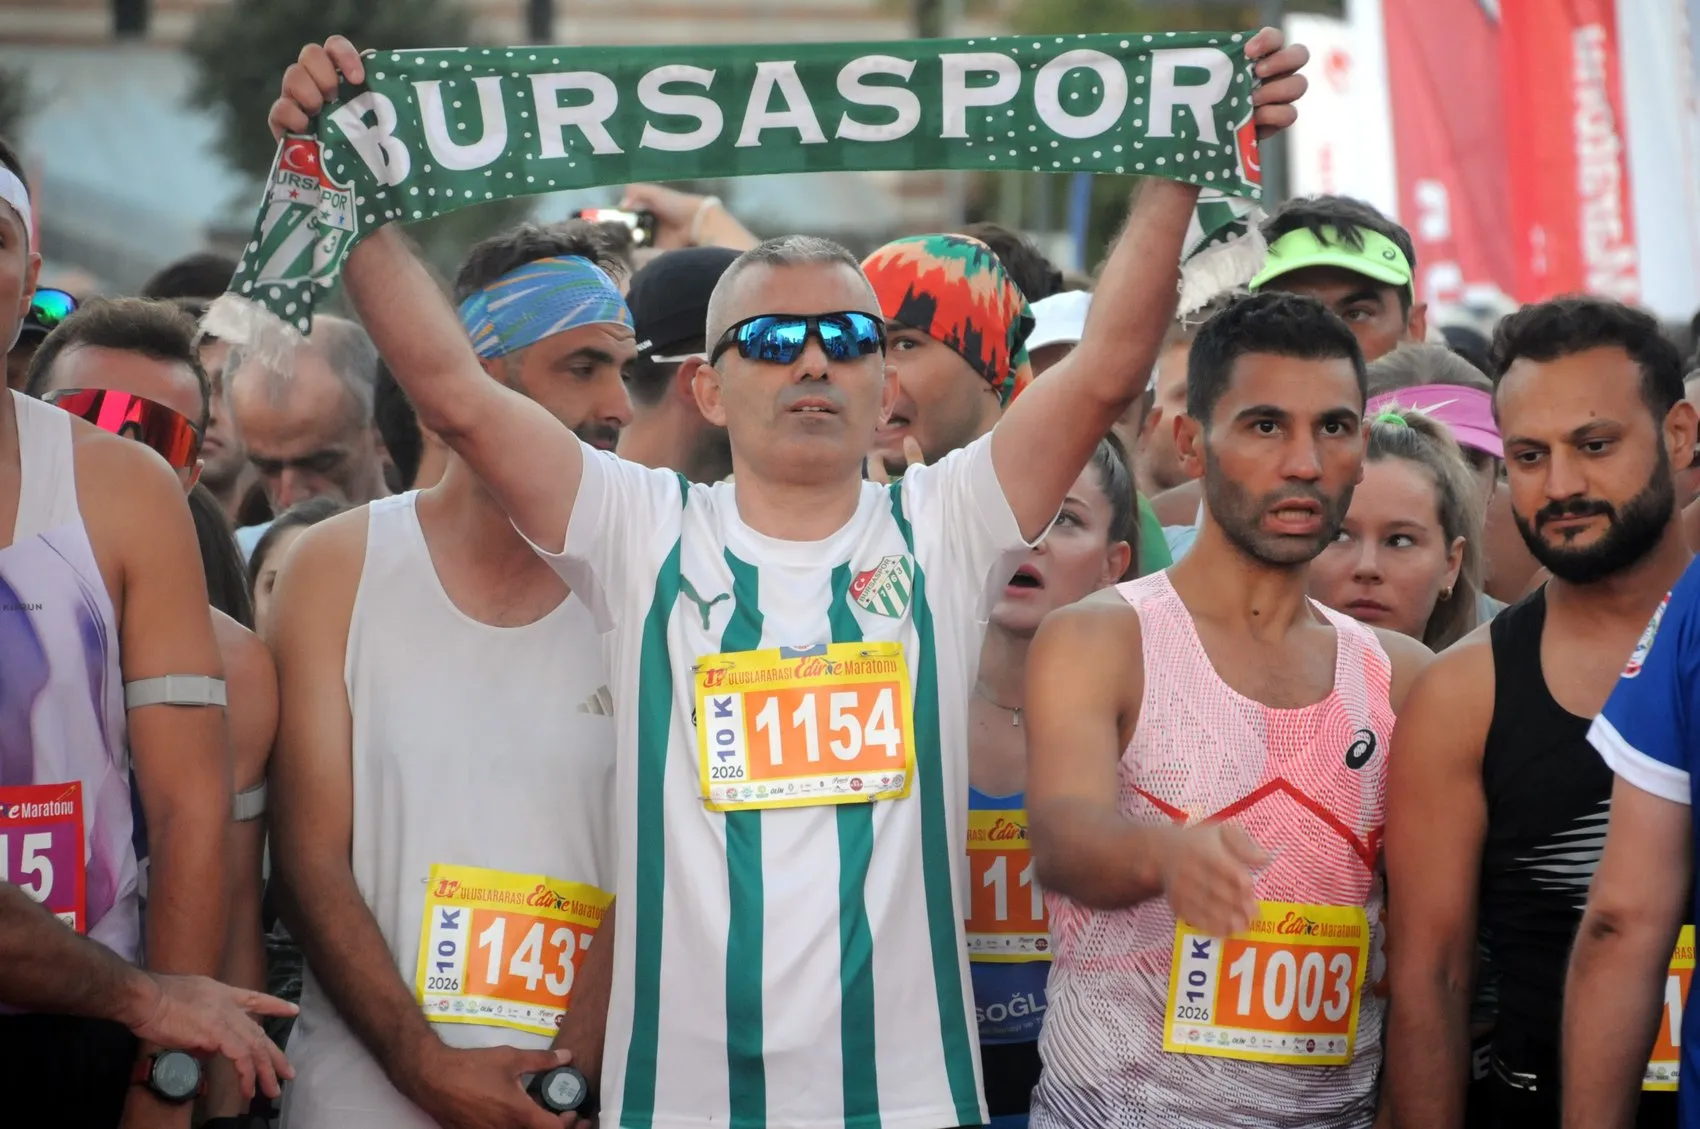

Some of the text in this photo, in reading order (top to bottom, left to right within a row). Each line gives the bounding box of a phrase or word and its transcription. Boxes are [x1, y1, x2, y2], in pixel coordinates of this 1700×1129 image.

[327, 47, 1234, 187] BURSASPOR
[728, 667, 793, 685] ULUSLARARASI
[844, 658, 898, 675] Maratonu
[713, 696, 736, 762] 10 K
[755, 687, 901, 766] 1154
[711, 764, 744, 779] 2026
[21, 800, 74, 819] Maratonu
[460, 887, 525, 905] ULUSLARARASI
[436, 908, 461, 974] 10 K
[1320, 922, 1361, 939] Maratonu
[478, 916, 594, 997] 143
[1186, 938, 1211, 1003] 10 K
[427, 976, 459, 991] 2026
[1229, 947, 1352, 1022] 1003
[1177, 1005, 1209, 1021] 2026
